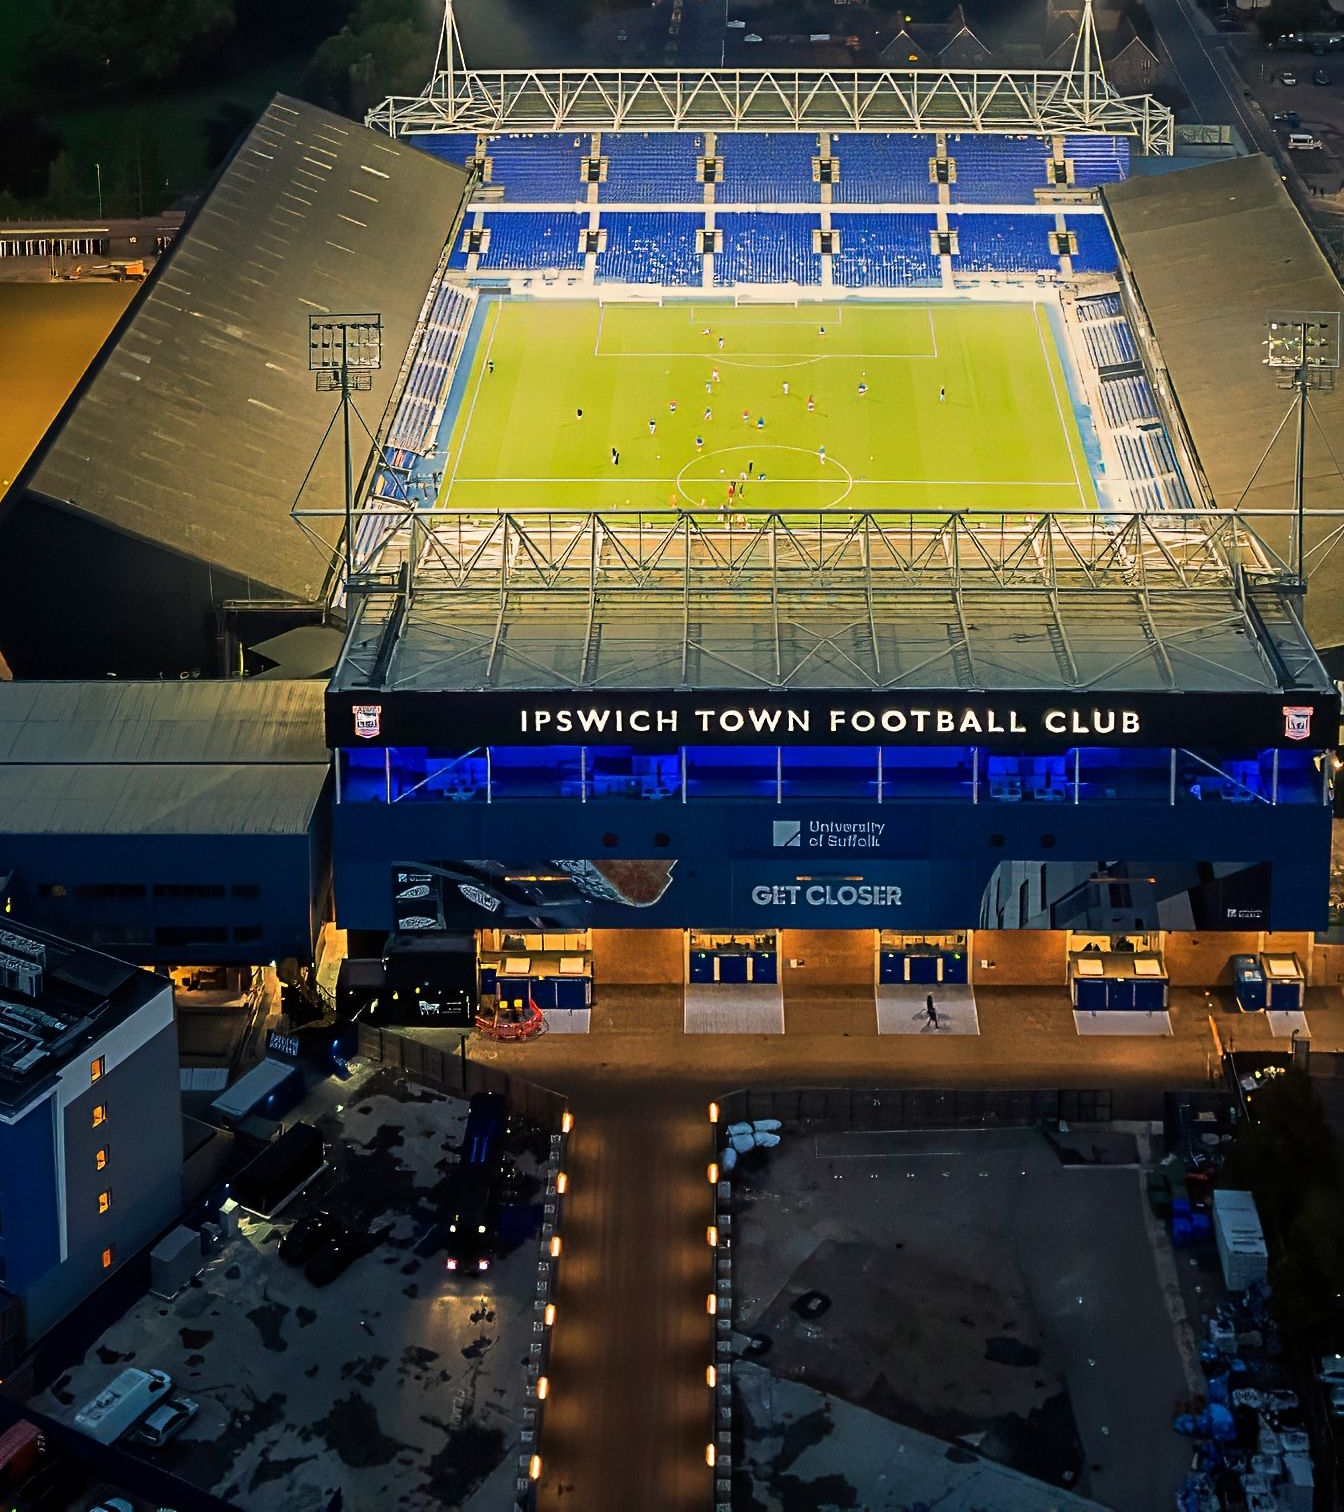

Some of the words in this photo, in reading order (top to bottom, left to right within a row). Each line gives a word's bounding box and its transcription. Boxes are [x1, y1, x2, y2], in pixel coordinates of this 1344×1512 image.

[520, 709, 677, 732] IPSWICH
[695, 708, 810, 732] TOWN
[830, 709, 1027, 733] FOOTBALL
[1044, 709, 1141, 733] CLUB
[809, 820, 886, 835] University
[809, 834, 823, 847] of
[827, 834, 880, 847] Suffolk
[751, 885, 802, 906] GET
[805, 885, 903, 906] CLOSER
